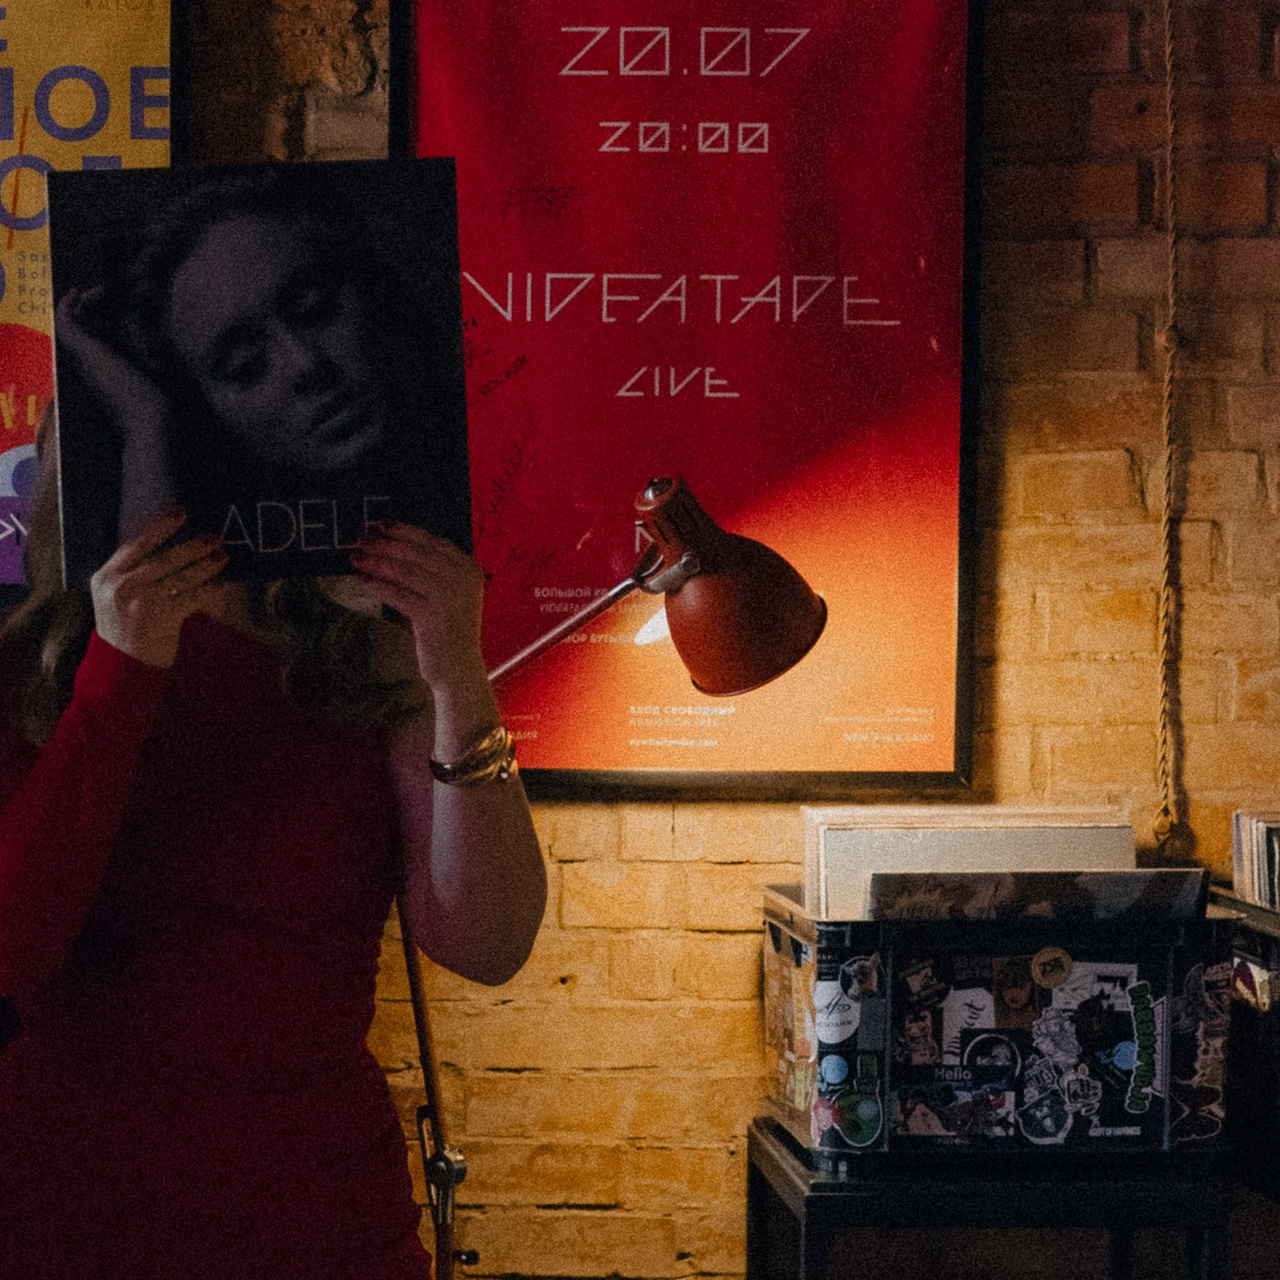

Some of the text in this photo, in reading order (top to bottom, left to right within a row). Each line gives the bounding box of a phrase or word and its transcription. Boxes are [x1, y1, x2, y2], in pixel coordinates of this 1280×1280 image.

[598, 121, 770, 154] 20:00
[616, 366, 741, 399] LIVE
[934, 1067, 973, 1080] Hello
